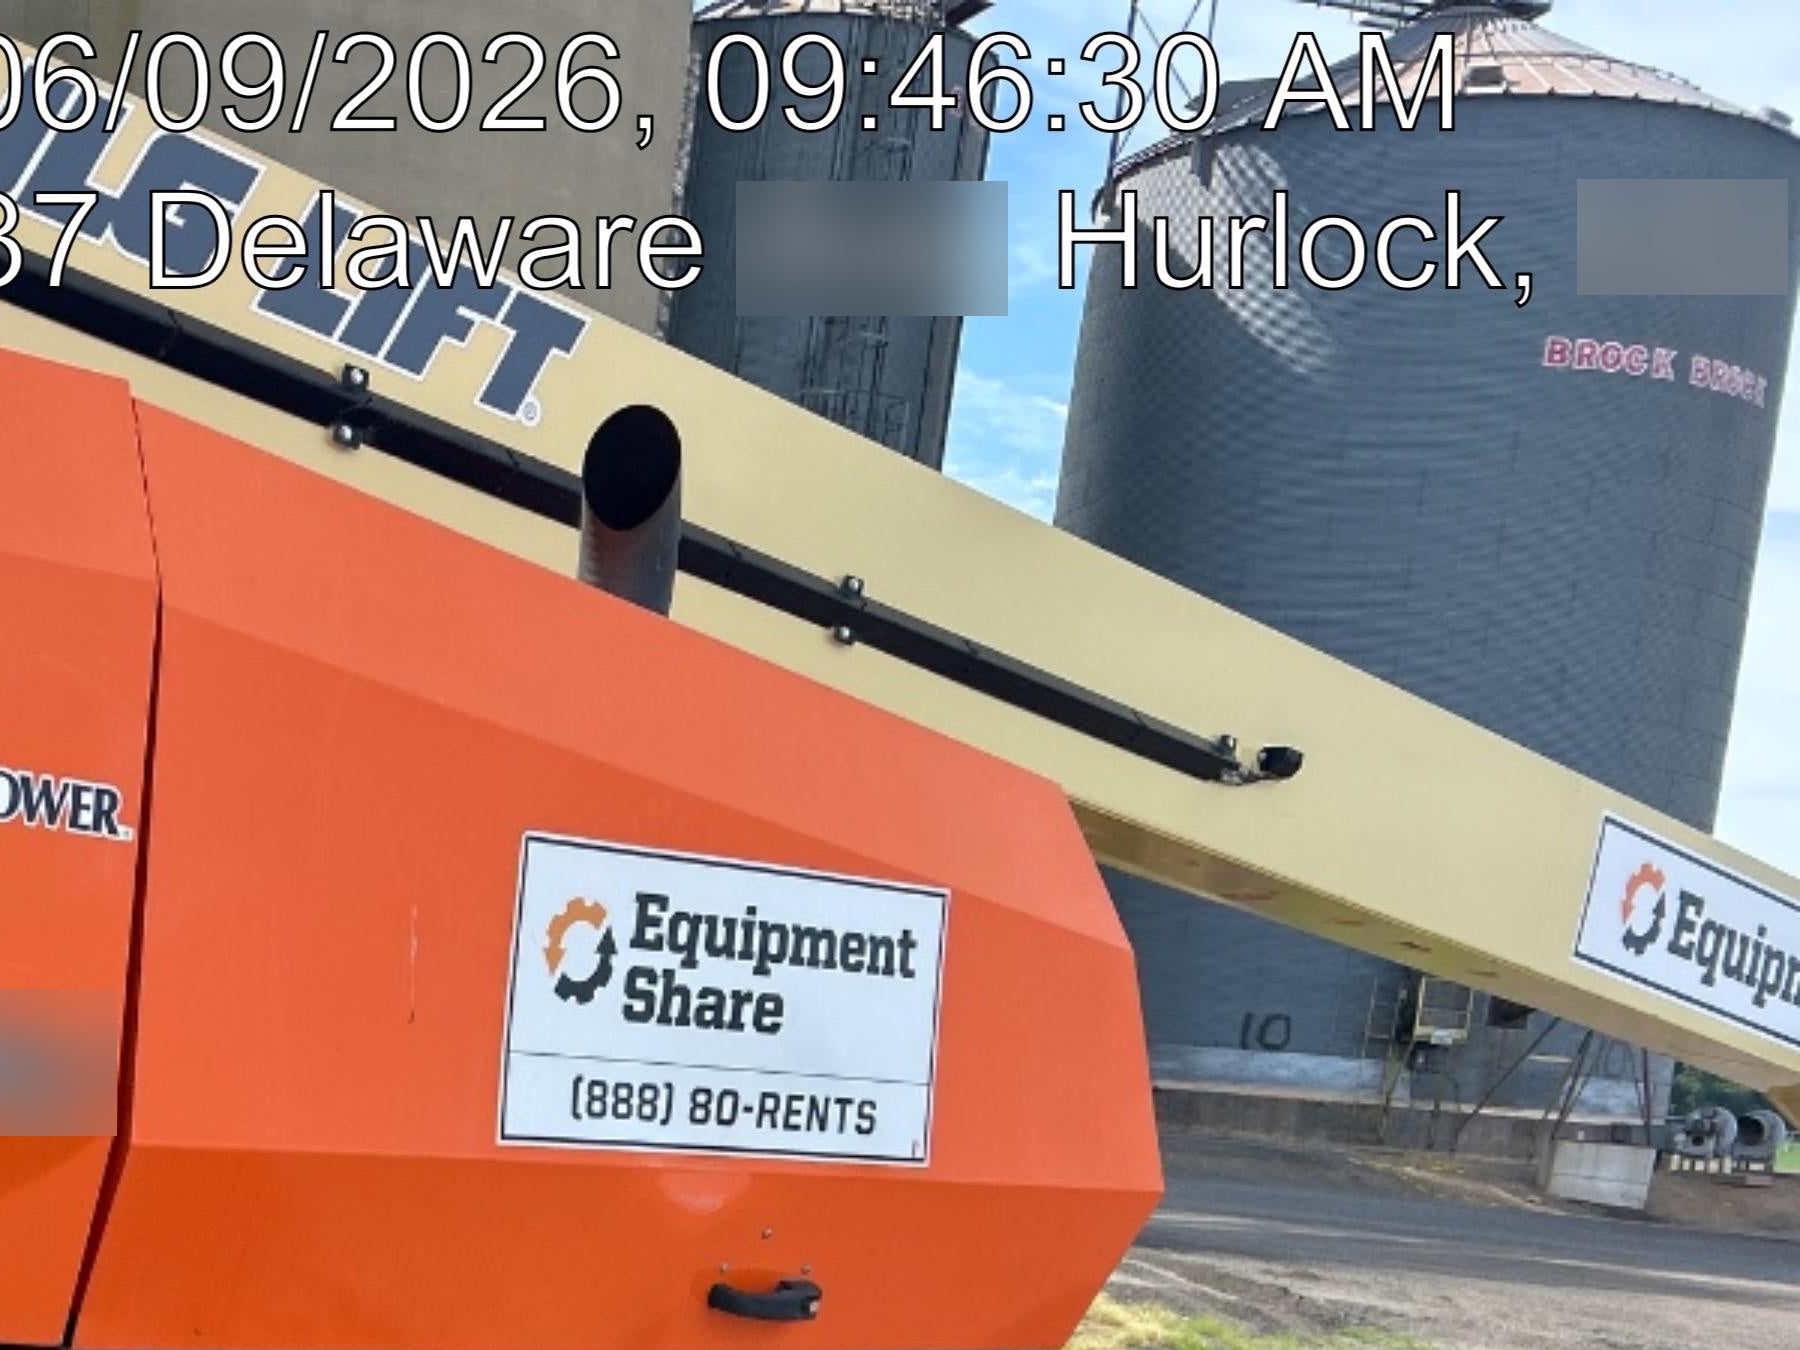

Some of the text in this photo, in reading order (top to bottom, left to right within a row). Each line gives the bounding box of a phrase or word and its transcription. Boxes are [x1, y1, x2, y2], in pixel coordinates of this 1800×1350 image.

[1542, 335, 1678, 382] BROCK
[629, 891, 918, 978] Equipment
[623, 965, 785, 1034] Share
[1241, 1012, 1291, 1051] 10
[571, 1075, 878, 1135] (888) 80-RENTS
